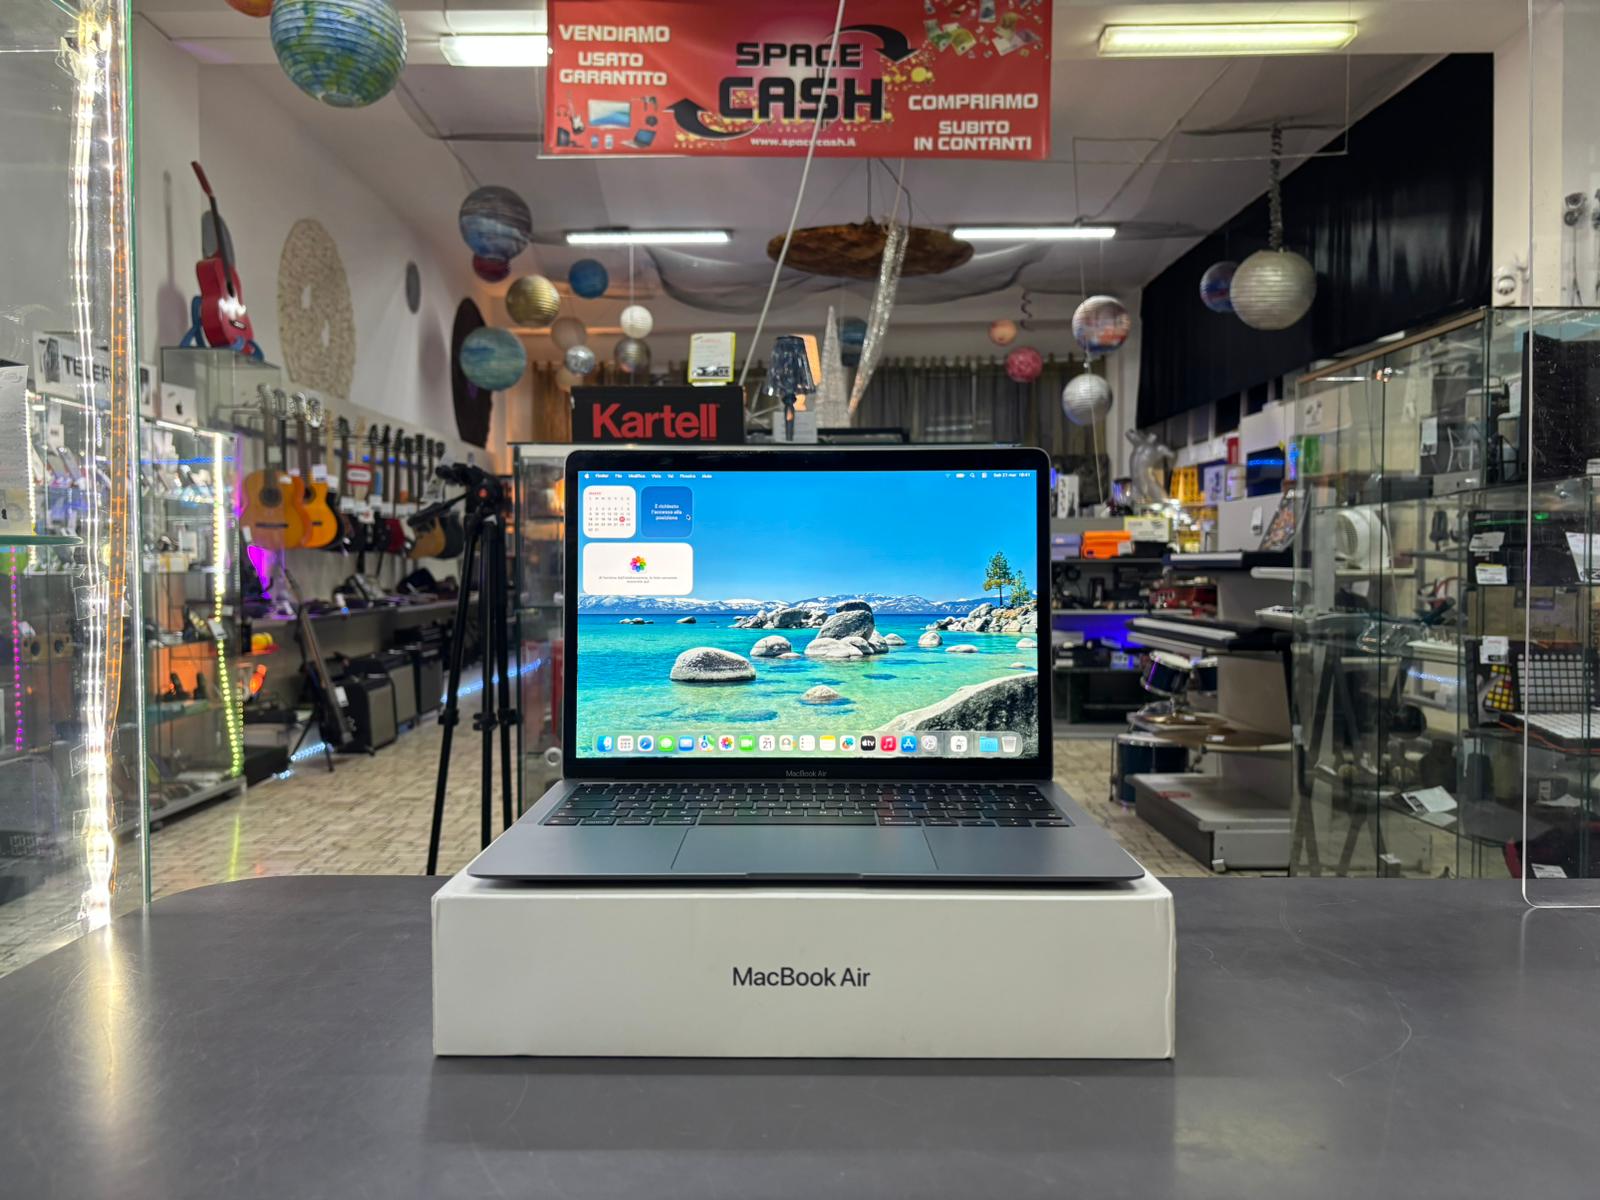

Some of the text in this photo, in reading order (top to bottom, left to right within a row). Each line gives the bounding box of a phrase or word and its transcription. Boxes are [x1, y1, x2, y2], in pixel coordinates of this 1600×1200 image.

[559, 24, 670, 43] VENDIAMO
[578, 51, 644, 67] USATO
[735, 42, 863, 68] SPACE
[559, 69, 668, 86] GARANTITO
[719, 76, 884, 121] CASH
[908, 93, 1039, 110] COMPRIAMO
[939, 120, 1010, 134] SUBITO
[913, 136, 1032, 151] IN CONTANTI
[592, 403, 718, 440] Kartell
[785, 769, 828, 777] MacBook Air
[732, 966, 871, 987] MacBook Air
